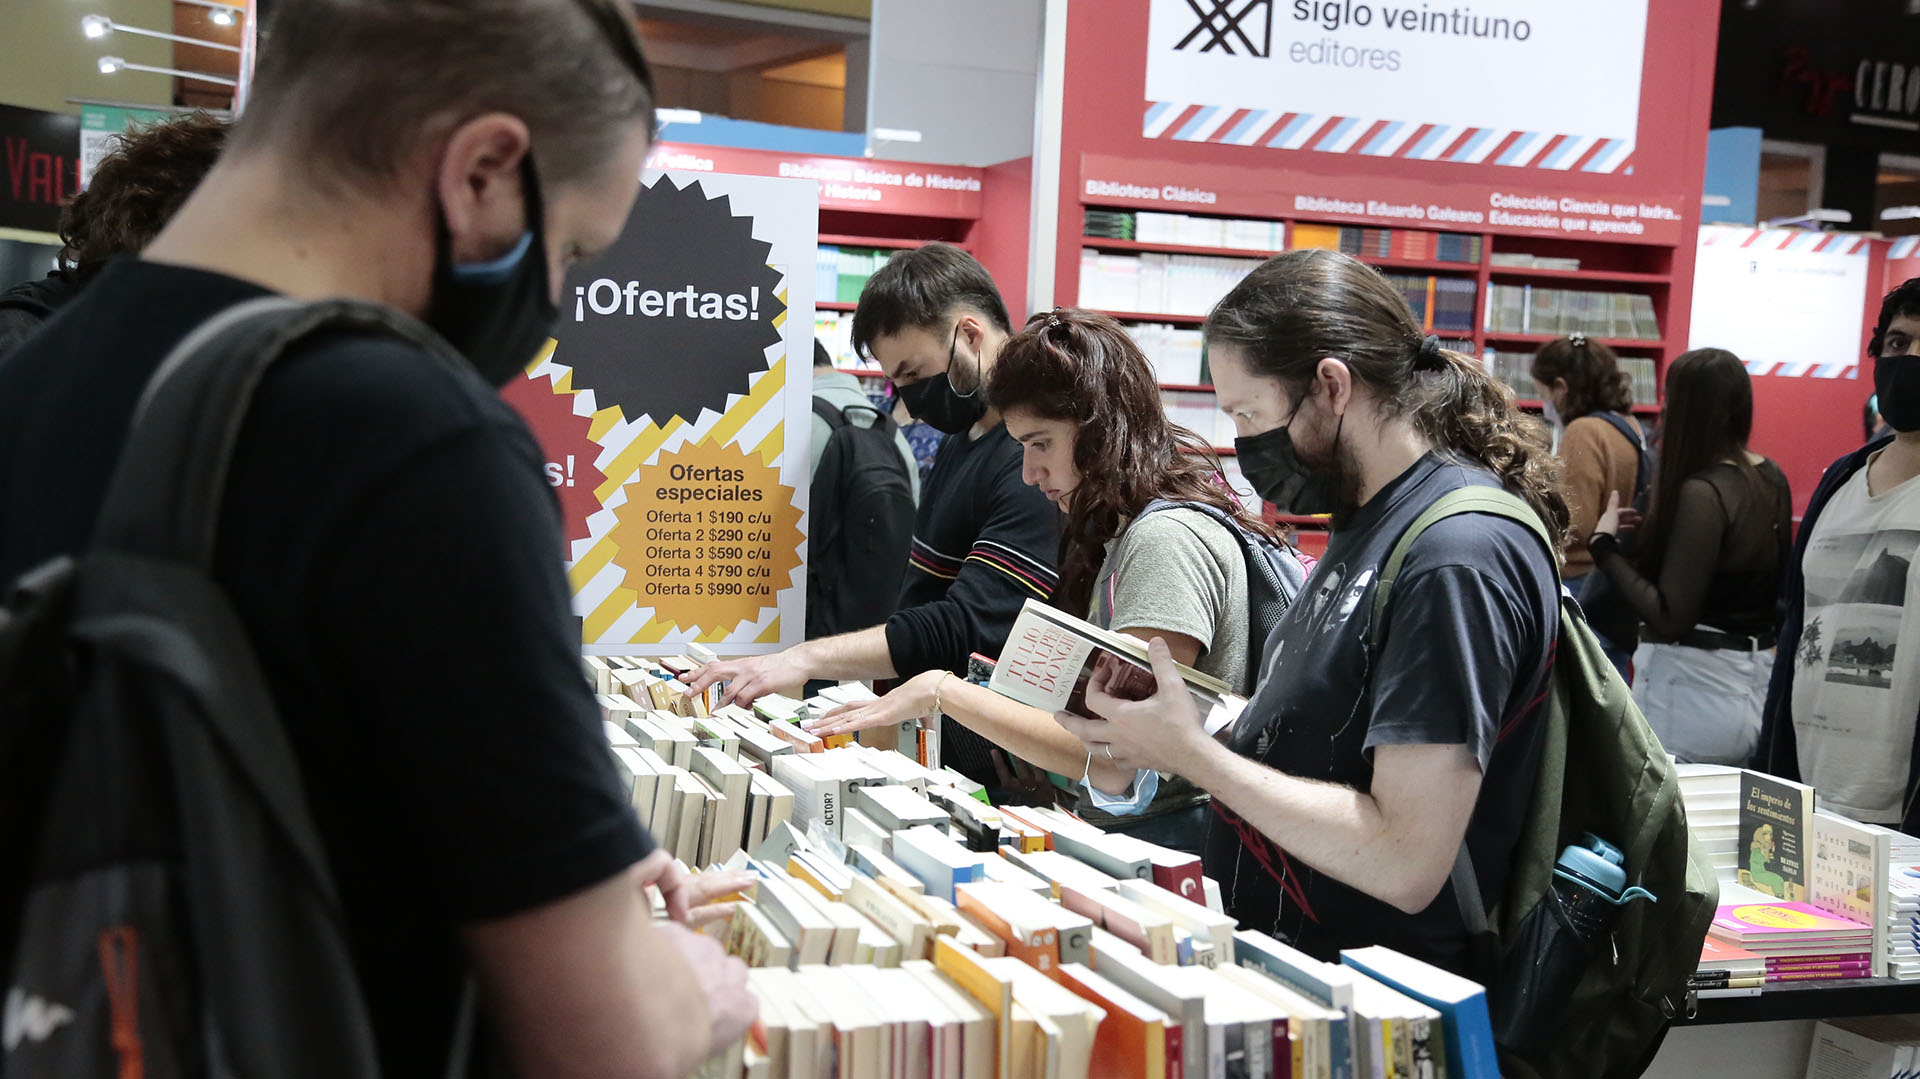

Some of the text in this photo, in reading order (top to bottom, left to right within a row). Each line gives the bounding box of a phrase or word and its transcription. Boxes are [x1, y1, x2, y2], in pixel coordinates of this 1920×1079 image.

[1293, 0, 1532, 42] siglo veintiuno
[1288, 37, 1402, 72] editores
[778, 162, 981, 192] Biblioteca Básica de Historia
[825, 184, 882, 201] Historia
[1085, 179, 1217, 204] Biblioteca Clásica
[1294, 195, 1484, 224] Biblioteca Eduardo Galeano
[1489, 191, 1558, 212] Colección
[1559, 197, 1610, 216] Ciencia
[1611, 204, 1638, 219] que
[1488, 209, 1644, 235] Educación que aprende
[574, 278, 760, 322] ¡Ofertas!
[669, 463, 745, 482] Ofertas
[655, 484, 764, 504] especiales
[646, 510, 772, 524] Oferta 1 $190 c/u
[646, 528, 771, 542] Oferta 2 $290 c/u
[645, 546, 771, 560] Oferta 3 $590 c/u
[645, 564, 771, 578] Oferta 4 $790 c/u
[645, 582, 770, 596] Oferta 5 $990 c/u
[1006, 627, 1041, 678] TULIO
[824, 792, 834, 826] OCTOR?
[1746, 799, 1756, 812] los
[1750, 786, 1760, 799] El
[1783, 798, 1792, 810] de
